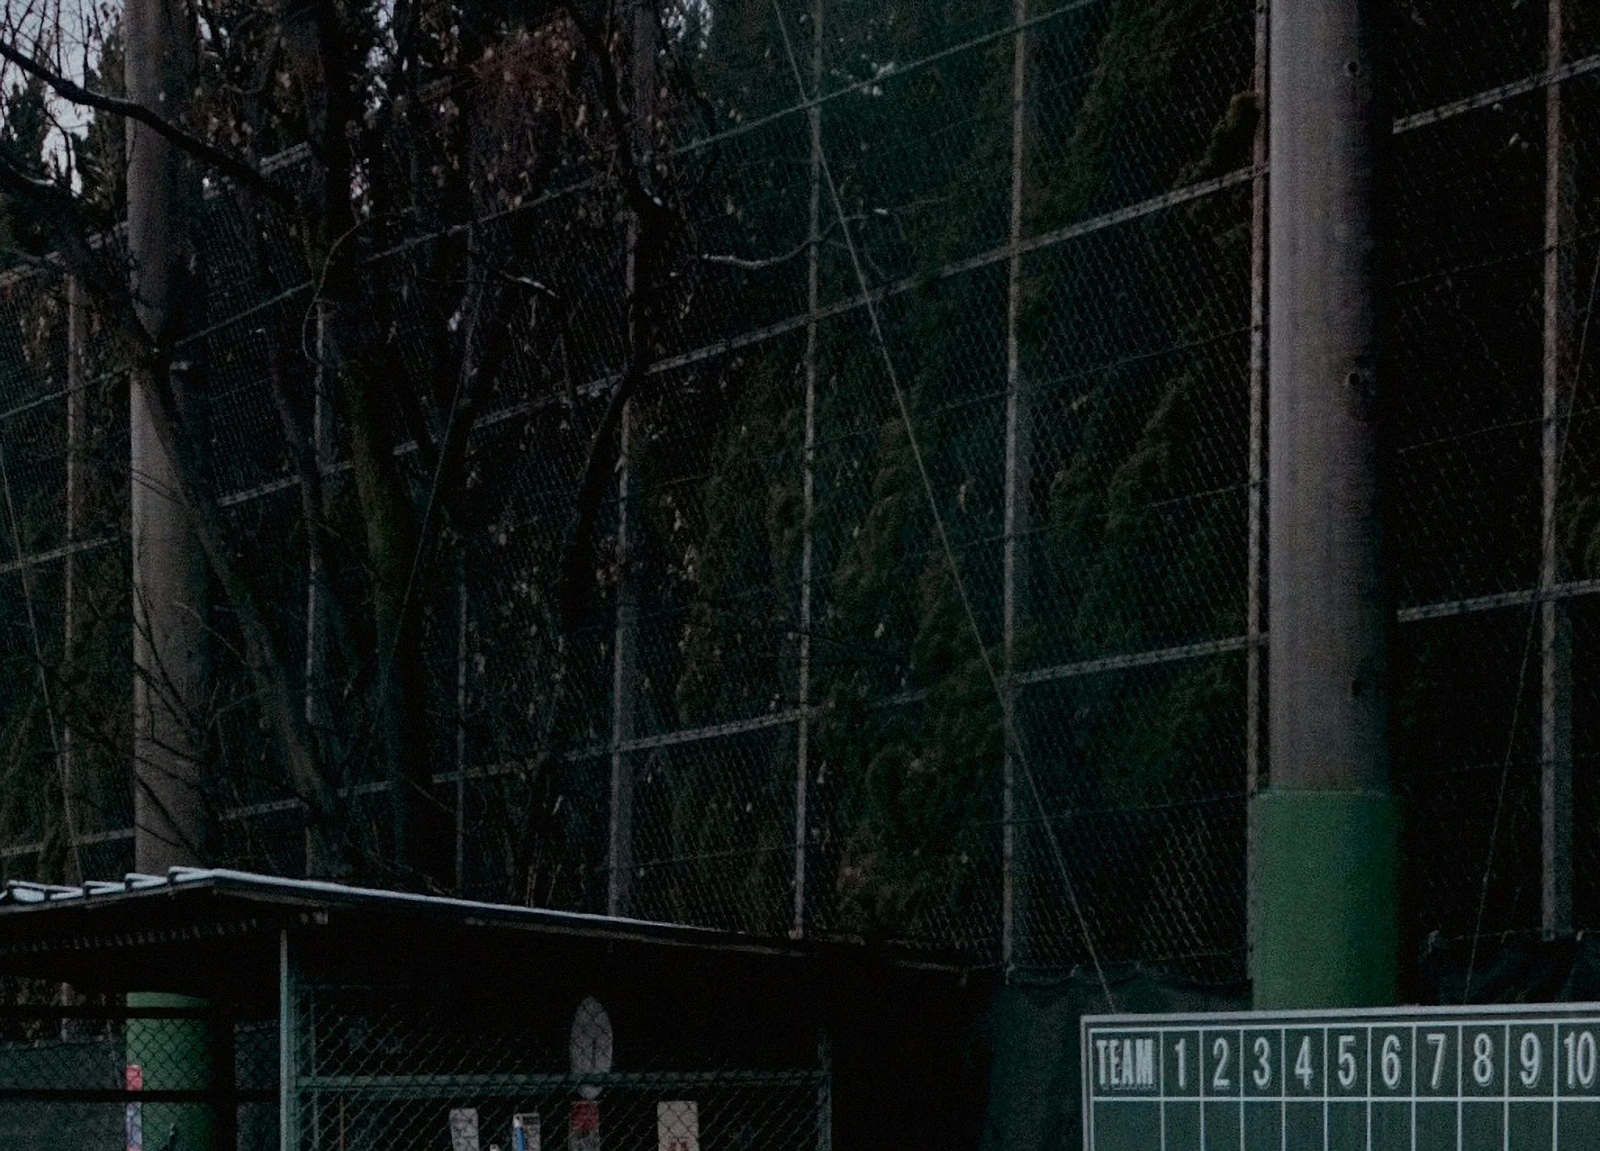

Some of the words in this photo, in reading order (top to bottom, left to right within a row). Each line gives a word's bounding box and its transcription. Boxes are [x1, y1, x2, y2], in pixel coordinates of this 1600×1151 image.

[1096, 1038, 1154, 1087] TEAM
[1175, 1037, 1187, 1089] 1
[1213, 1037, 1231, 1088] 2
[1253, 1036, 1271, 1088] 3
[1294, 1035, 1313, 1089] 4
[1338, 1035, 1357, 1088] 5
[1381, 1034, 1401, 1088] 6
[1427, 1033, 1447, 1088] 7
[1473, 1033, 1493, 1086] 8
[1520, 1031, 1542, 1088] 9
[1563, 1031, 1597, 1088] 10
